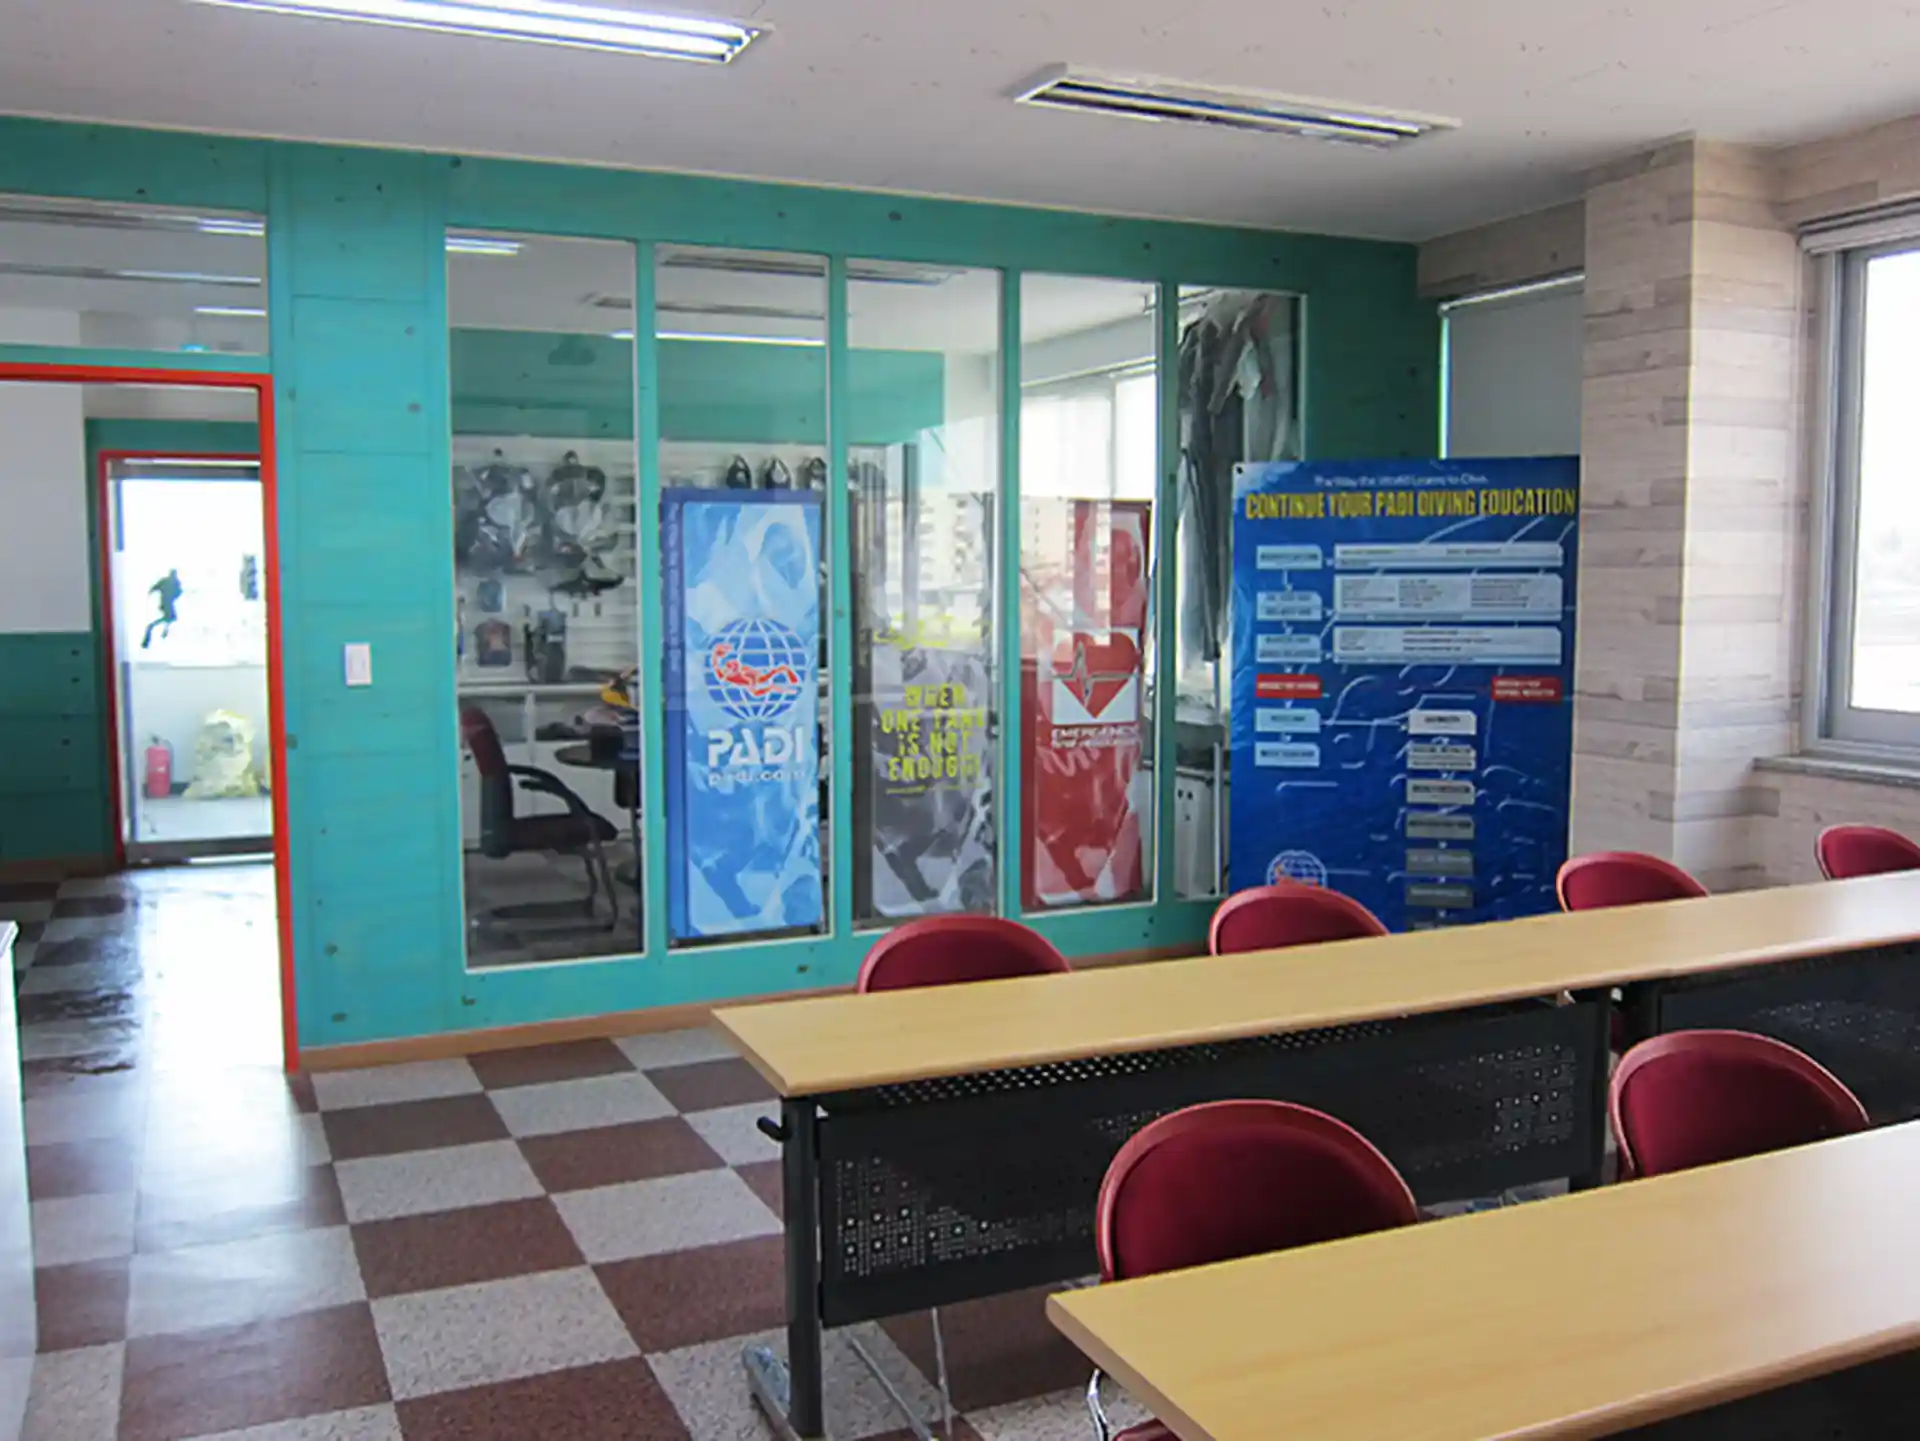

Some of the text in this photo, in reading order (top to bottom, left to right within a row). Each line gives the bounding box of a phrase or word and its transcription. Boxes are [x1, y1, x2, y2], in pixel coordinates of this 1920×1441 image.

[1245, 487, 1577, 519] CONTINUE YOUR PADI DIVING EDUCATION
[881, 708, 921, 734] ONE
[707, 726, 804, 769] PADI
[929, 730, 973, 755] NOT
